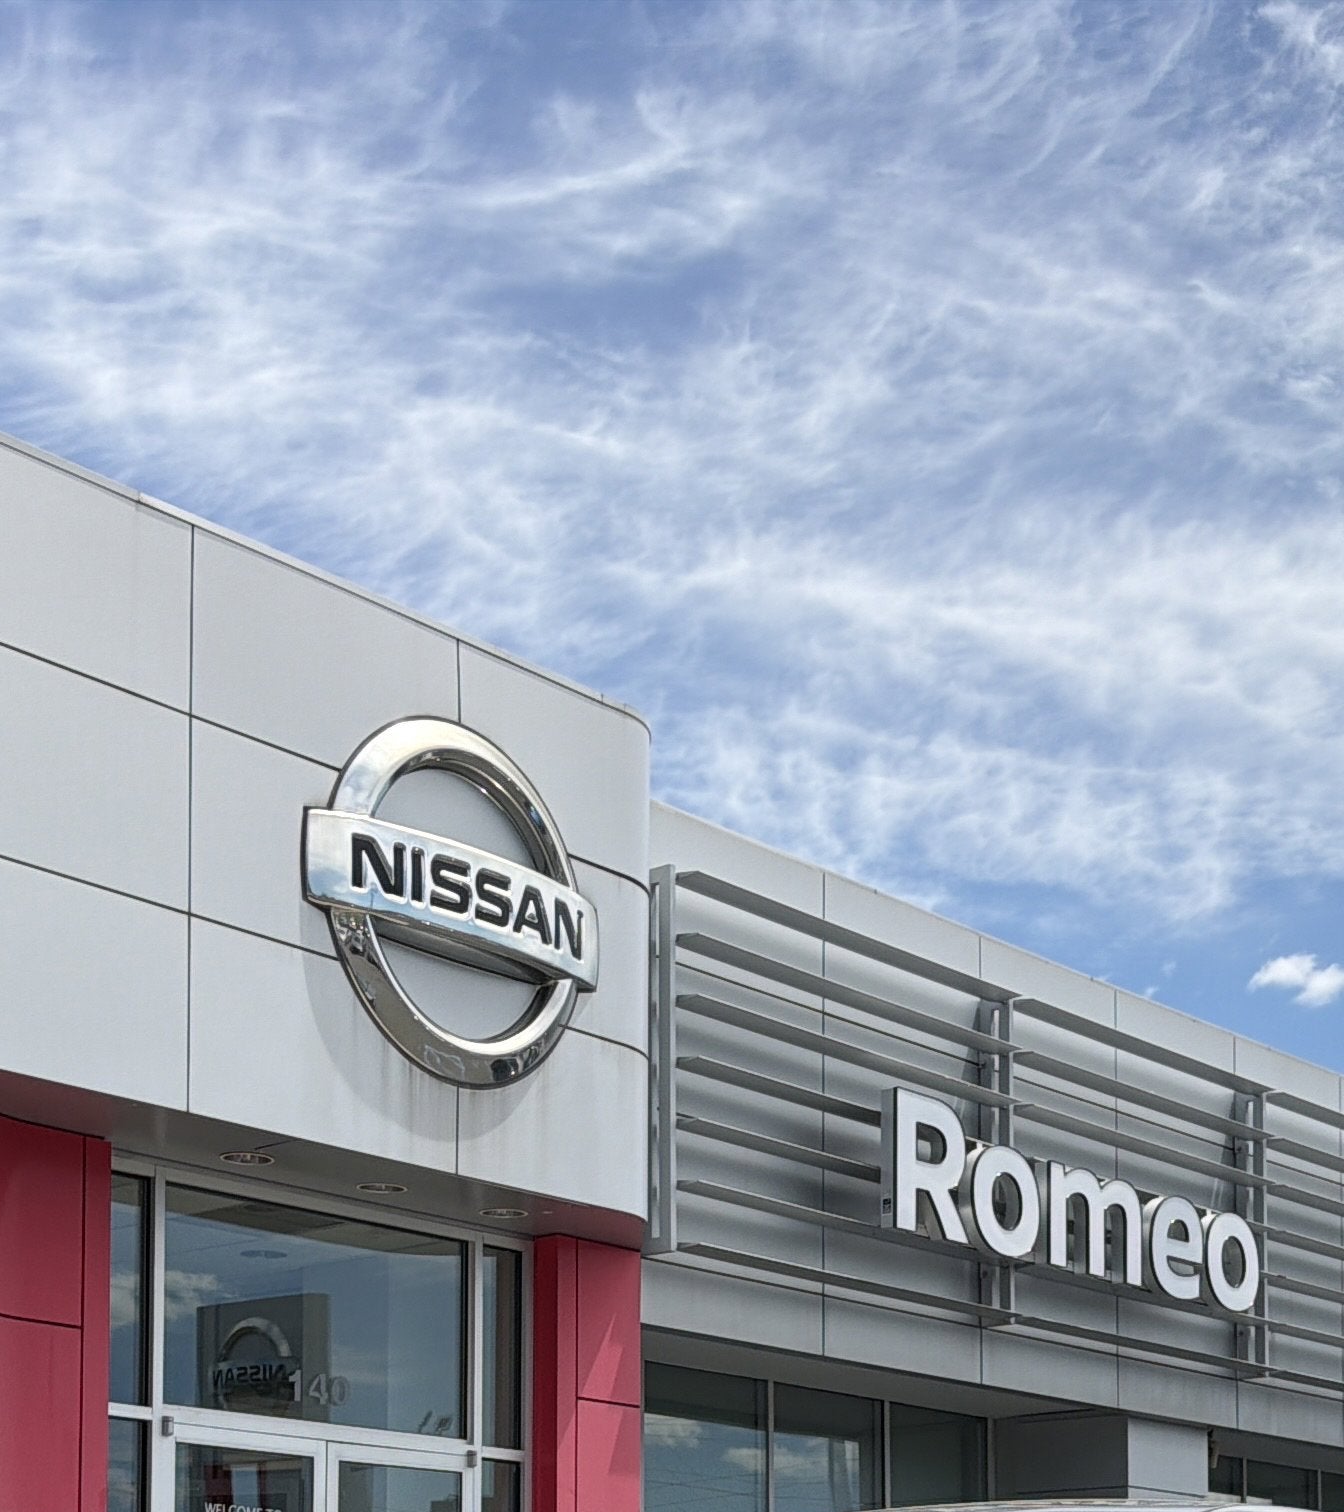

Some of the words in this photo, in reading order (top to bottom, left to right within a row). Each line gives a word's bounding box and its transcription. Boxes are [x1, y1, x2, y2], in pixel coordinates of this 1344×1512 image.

[351, 832, 584, 961] NISSAN
[886, 1087, 1260, 1312] Romeo
[289, 1369, 350, 1406] 140
